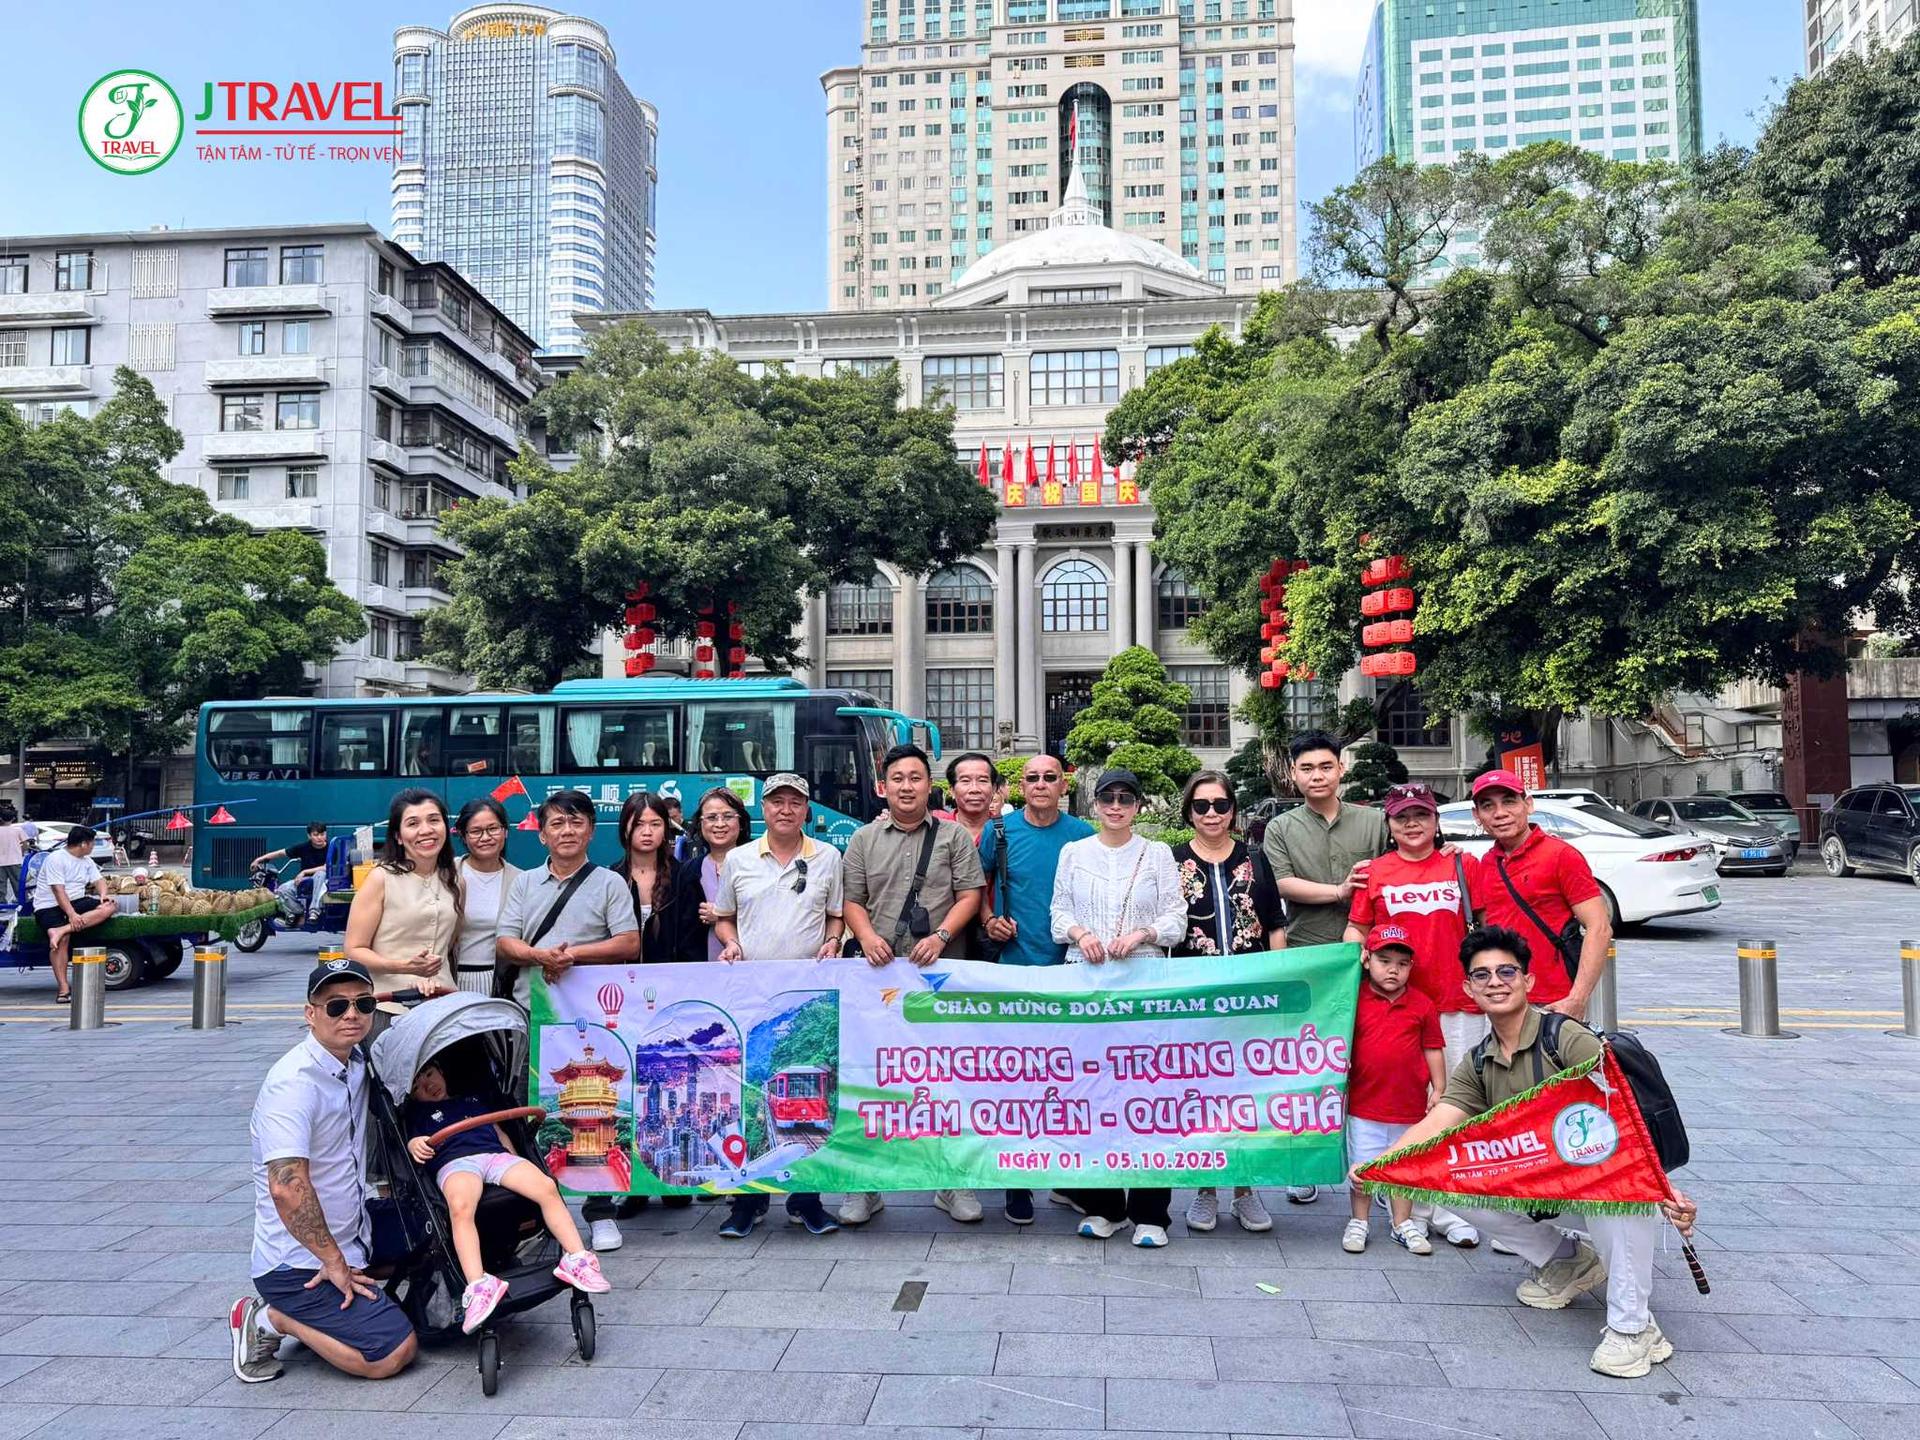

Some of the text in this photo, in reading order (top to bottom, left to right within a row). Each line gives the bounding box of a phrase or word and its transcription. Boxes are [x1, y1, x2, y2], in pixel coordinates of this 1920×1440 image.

[933, 1001, 992, 1016] CHÀO
[998, 1001, 1061, 1016] MỪNG
[1140, 998, 1206, 1014] THAM
[1213, 994, 1280, 1013] QUAN
[876, 1046, 1074, 1087] HONGKONG
[1107, 1041, 1235, 1083] TRUNG
[1243, 1024, 1349, 1076] QUỐC
[858, 1086, 961, 1141] THẨM
[1125, 1089, 1258, 1137] QUẢNG
[1267, 1086, 1346, 1136] CHÂ
[998, 1149, 1050, 1170] NGÀY
[1059, 1152, 1082, 1169] 01
[1106, 1152, 1227, 1169] 05.10.2025
[1462, 1130, 1547, 1162] TRAVEL
[1570, 1142, 1605, 1158] TRAVEL
